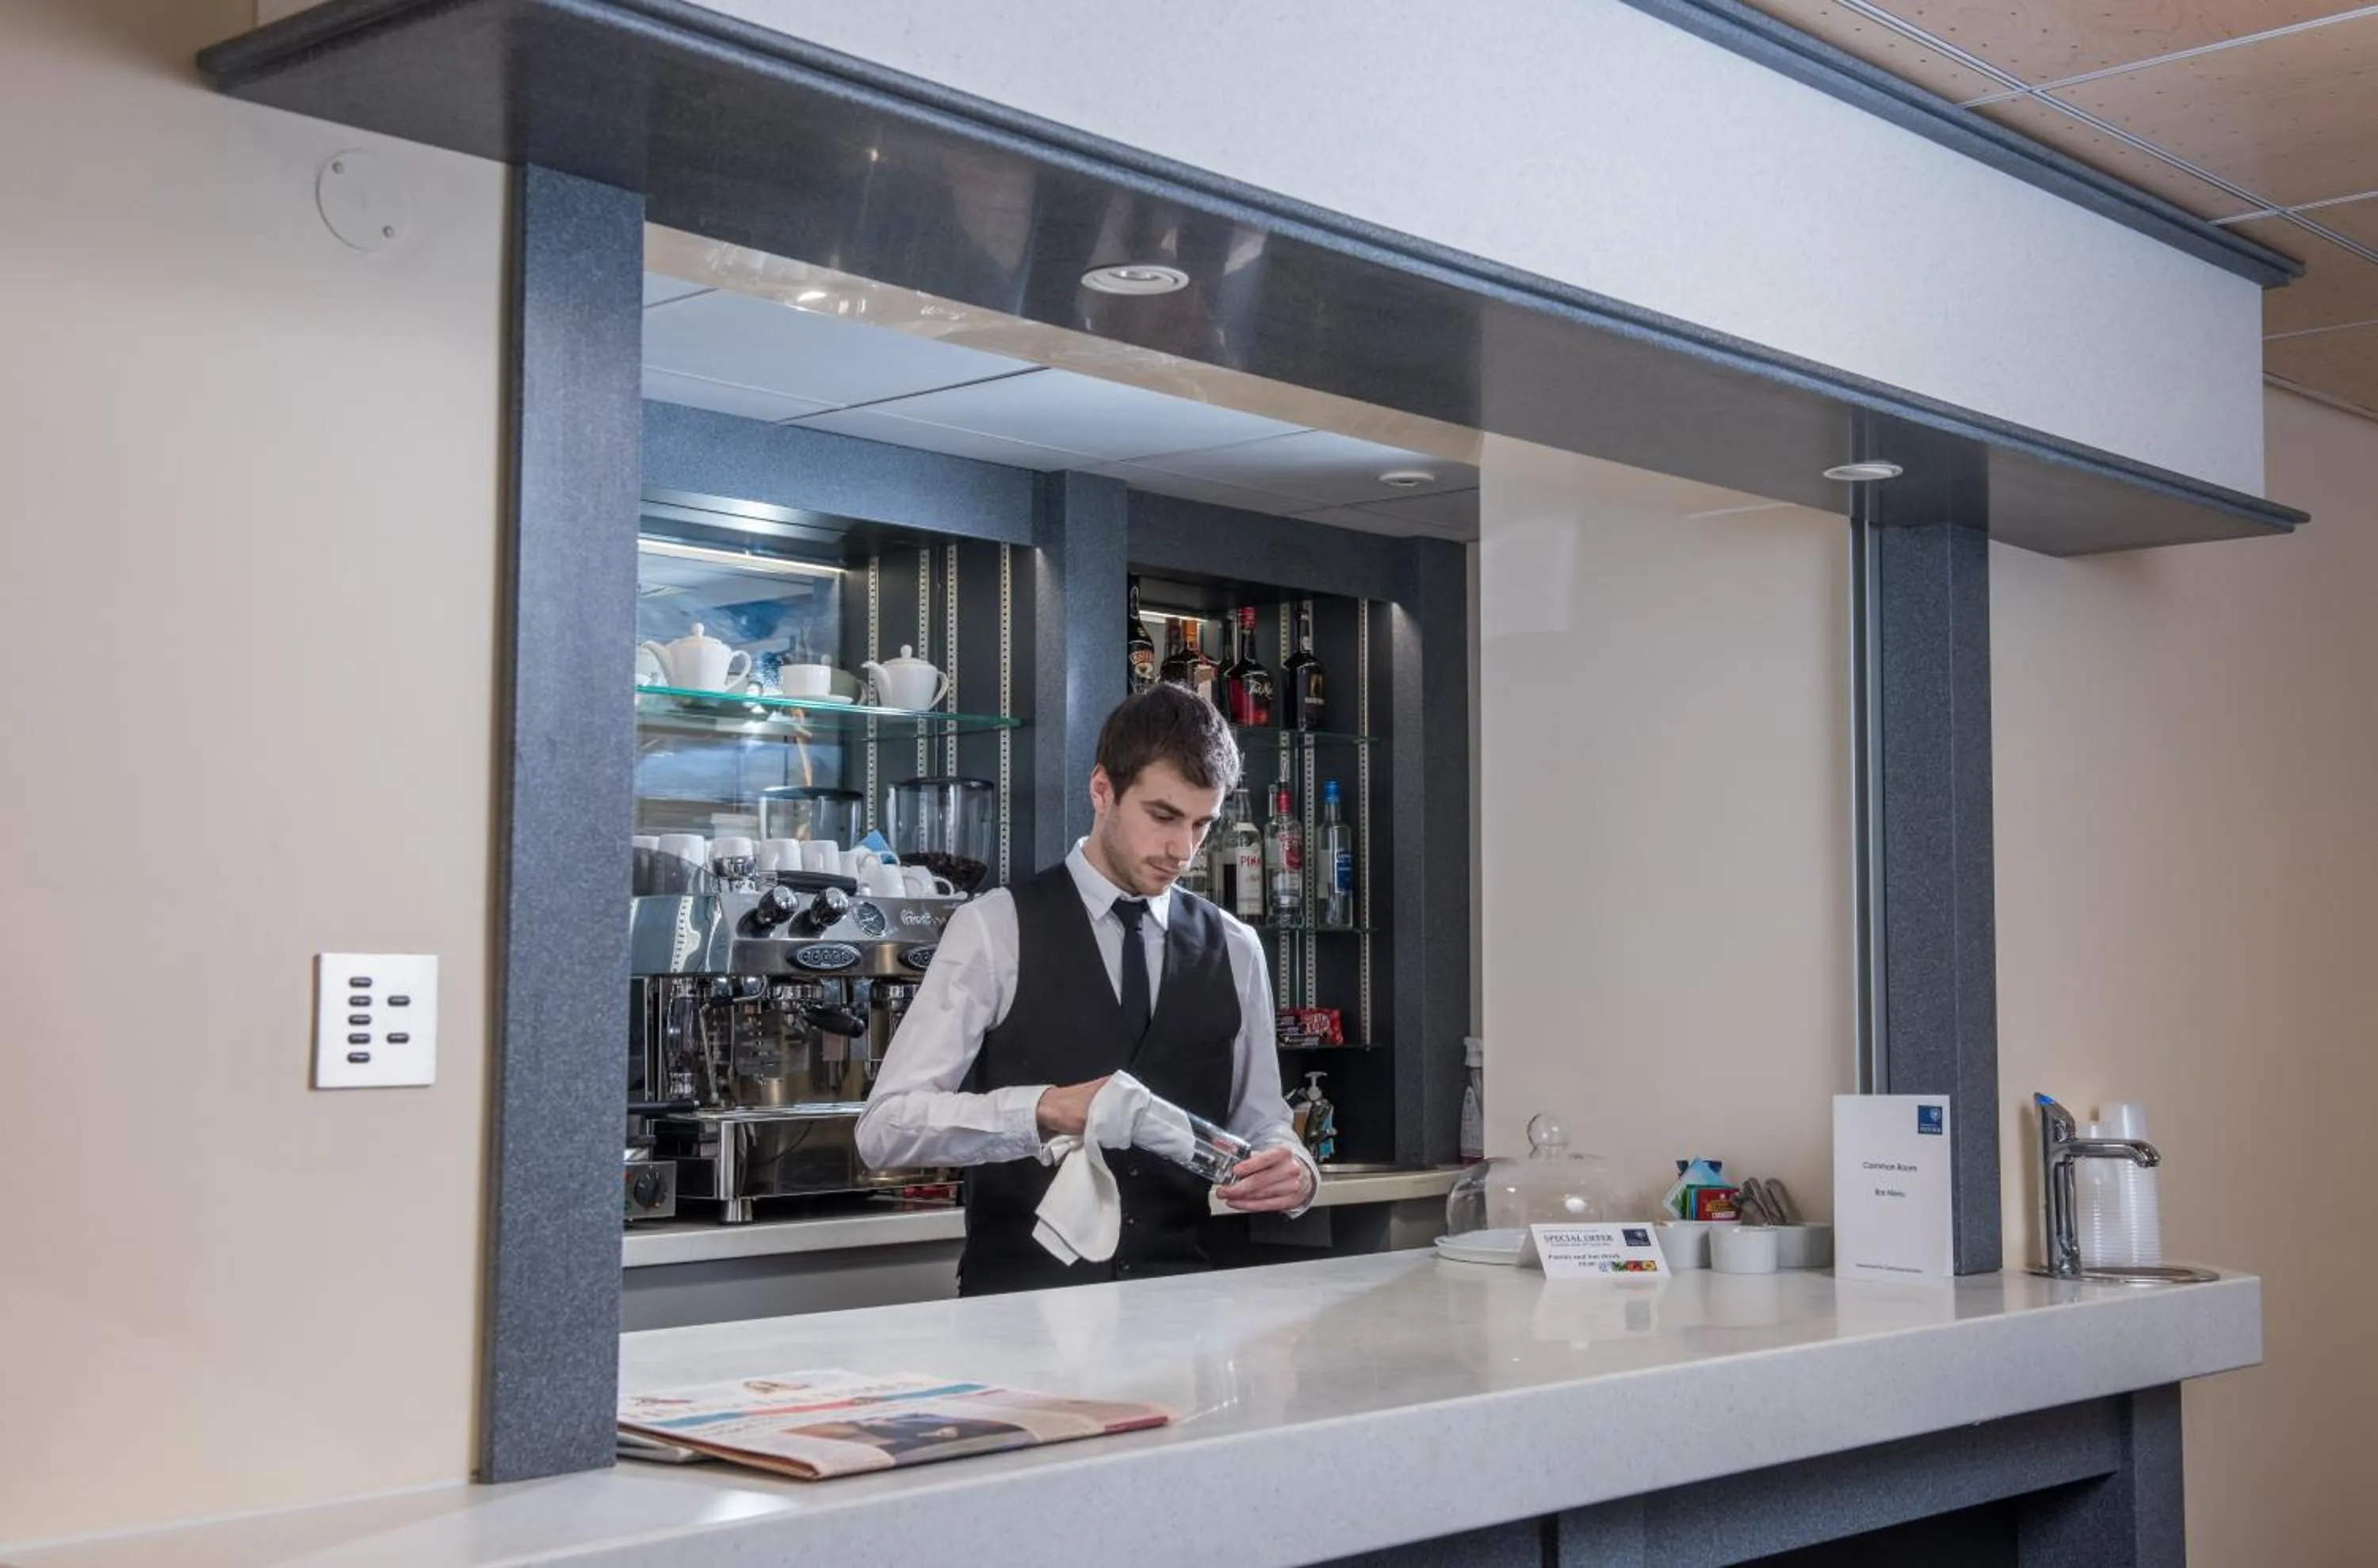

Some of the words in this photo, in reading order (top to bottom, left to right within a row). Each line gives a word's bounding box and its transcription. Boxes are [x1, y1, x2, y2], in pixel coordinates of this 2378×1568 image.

[1863, 1161, 1895, 1171] Common
[1897, 1163, 1917, 1172] Room
[1543, 1233, 1582, 1243] SPECIAL
[1583, 1233, 1614, 1242] OFFER
